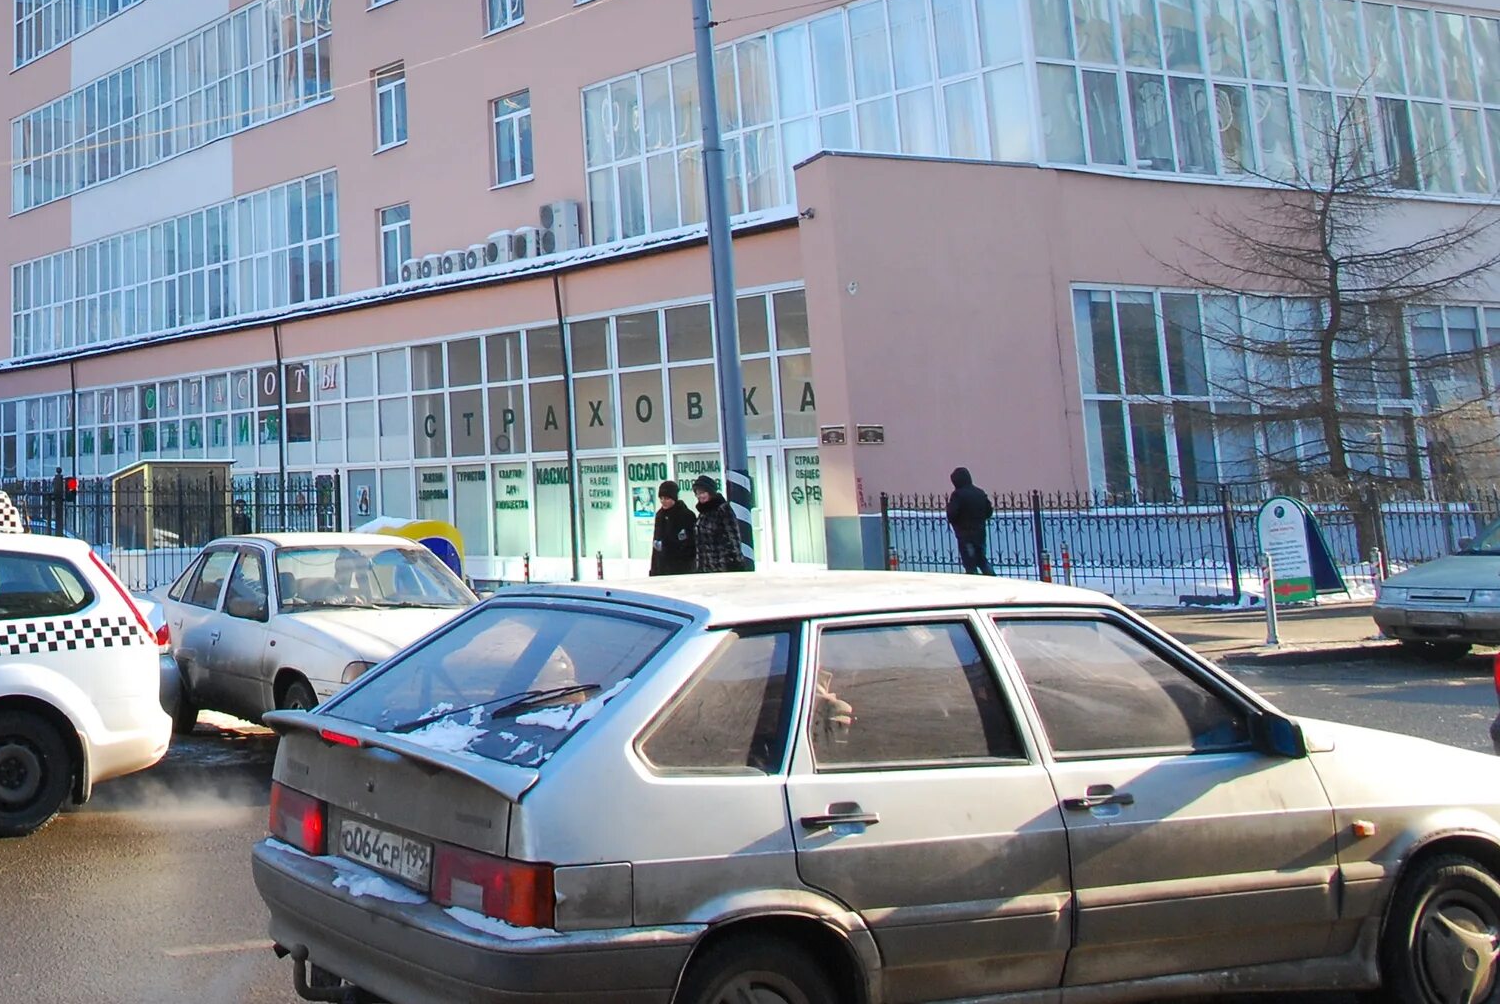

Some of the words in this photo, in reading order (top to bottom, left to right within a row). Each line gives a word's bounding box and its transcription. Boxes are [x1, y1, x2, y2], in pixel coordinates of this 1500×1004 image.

[31, 392, 133, 421] СТУИЯ
[167, 364, 337, 409] КРАСОТЫ
[425, 382, 816, 439] СТРАХОВКА
[536, 466, 569, 485] КАСКО
[628, 462, 667, 481] ОСАГО
[678, 460, 721, 474] ПРОДАЖА
